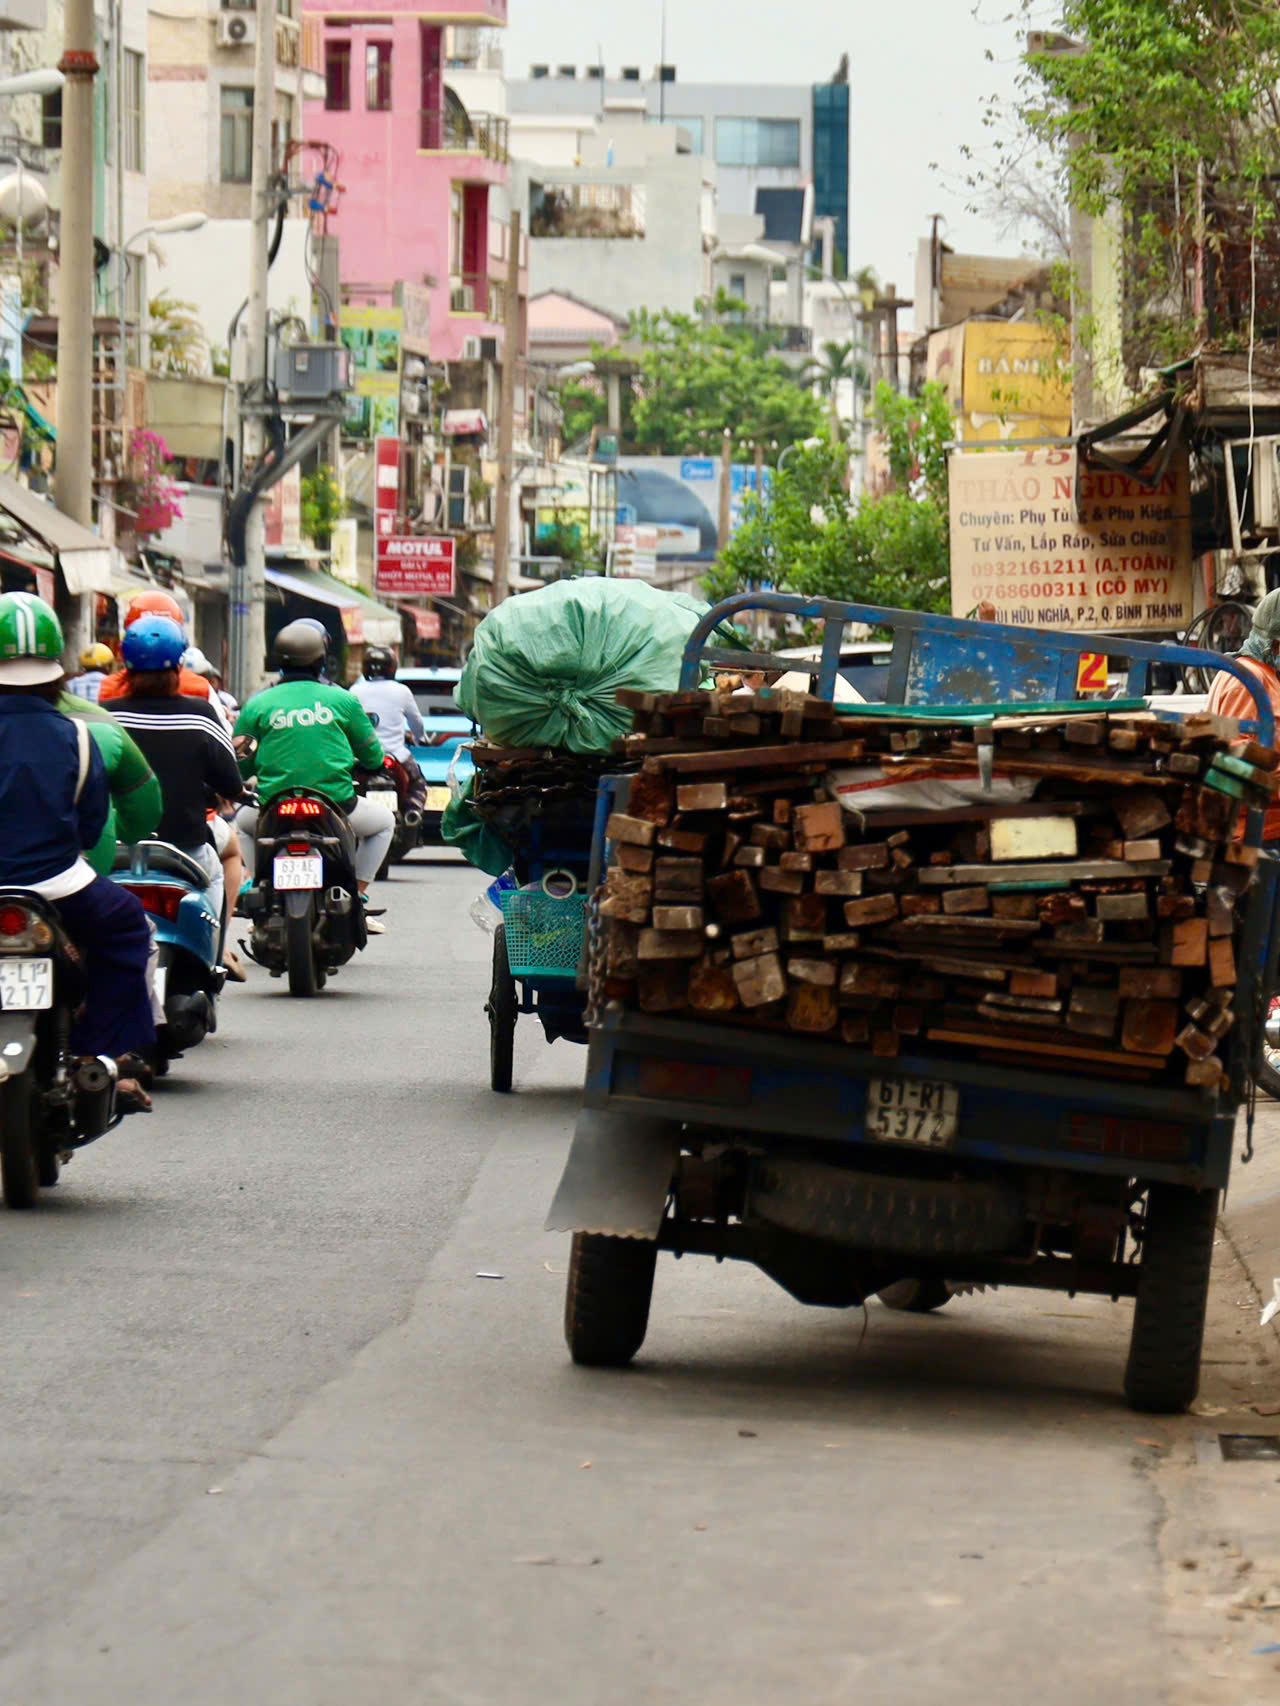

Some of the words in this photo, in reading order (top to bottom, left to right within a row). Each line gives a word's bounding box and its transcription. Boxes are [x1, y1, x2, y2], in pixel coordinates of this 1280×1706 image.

[1019, 509, 1046, 526] Phụ
[1051, 506, 1087, 525] Tùg
[386, 541, 443, 556] MOTUL
[1063, 533, 1095, 550] Ráp,
[971, 558, 1086, 577] 0932161211
[972, 581, 1088, 601] 0768600311
[1133, 578, 1168, 595] MY)
[1116, 601, 1142, 620] BÌNH
[1146, 603, 1183, 622] THẠNH
[269, 701, 334, 729] Grab
[876, 1106, 945, 1142] 5372
